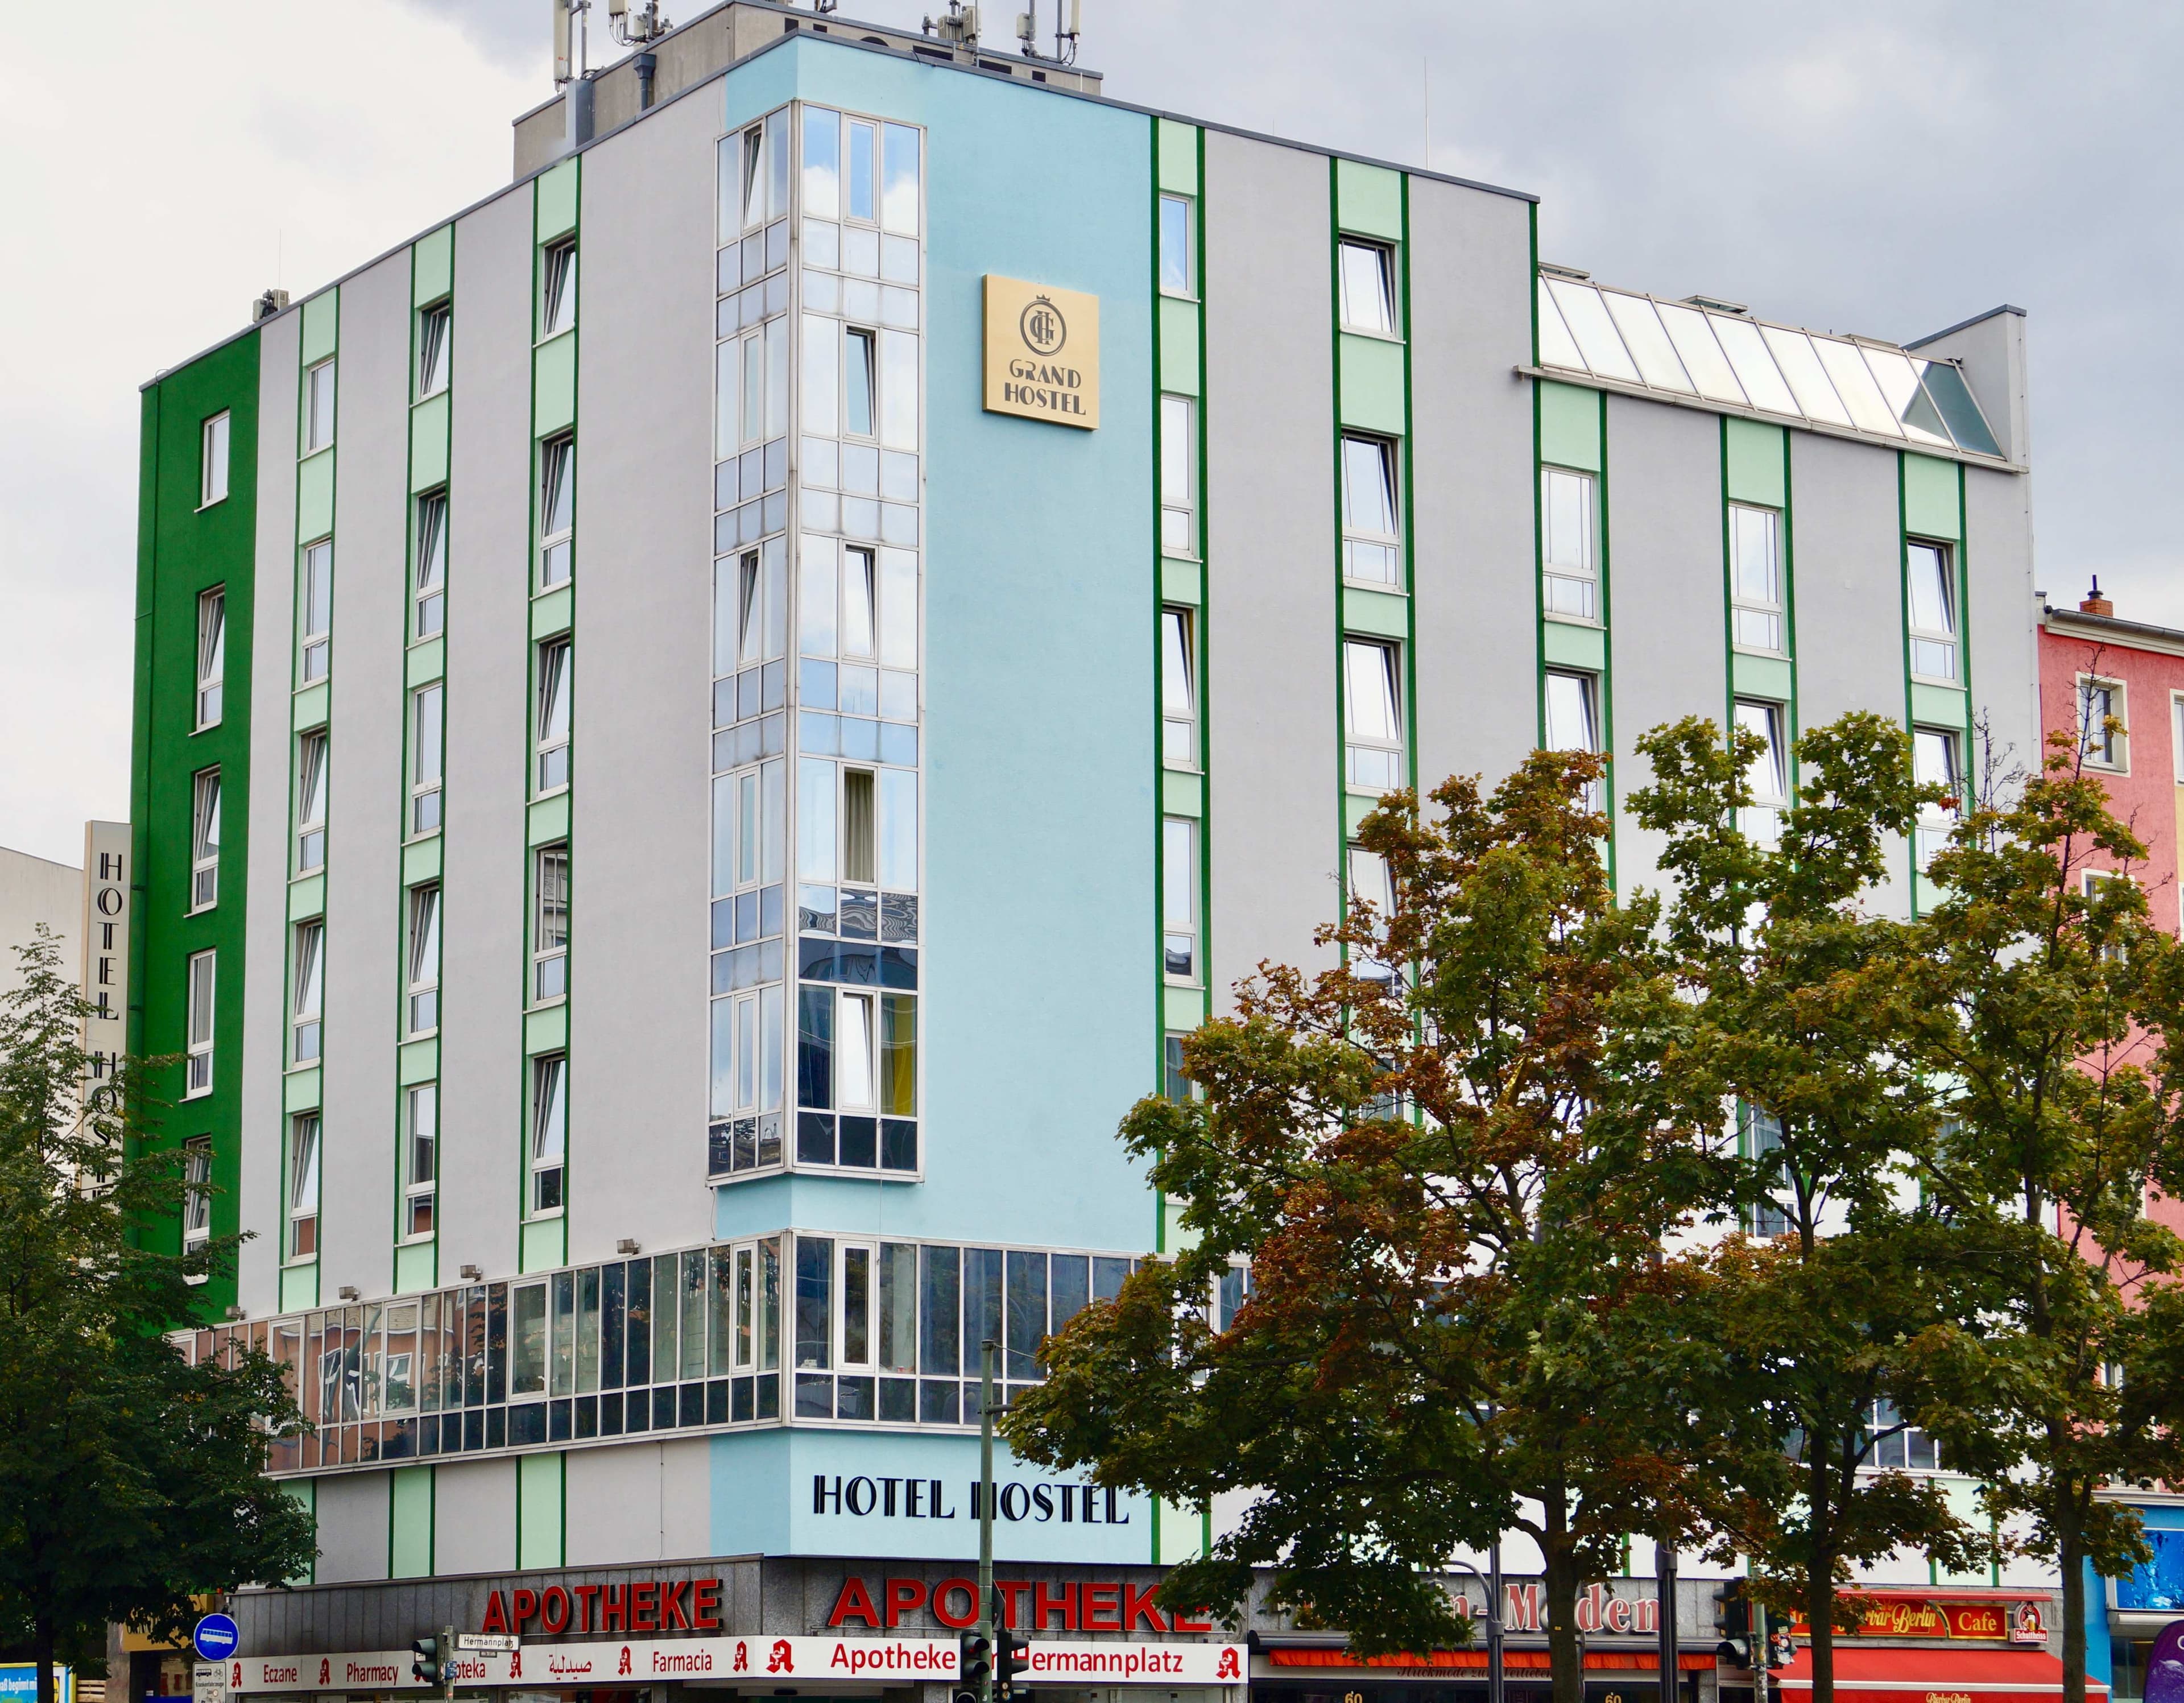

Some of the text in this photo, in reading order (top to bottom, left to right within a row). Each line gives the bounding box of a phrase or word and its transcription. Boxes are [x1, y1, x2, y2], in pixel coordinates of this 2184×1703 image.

[1009, 358, 1082, 389] GRAND
[1004, 382, 1086, 416] HOSTEL
[97, 852, 123, 1020] HOTEL
[813, 1474, 1130, 1524] HOTEL HOSTEL
[482, 1578, 719, 1634] APOTHEKE
[1892, 1603, 1936, 1634] Berlin
[1958, 1612, 1997, 1631] Cafe
[464, 1636, 514, 1648] Hermannplatz
[2016, 1631, 2046, 1640] Schultheiss
[263, 1664, 297, 1683] Eczane
[347, 1662, 399, 1686] Pharmacy
[454, 1657, 486, 1684] pteka
[652, 1648, 712, 1672] Farmacia
[830, 1643, 957, 1675] Apotheke
